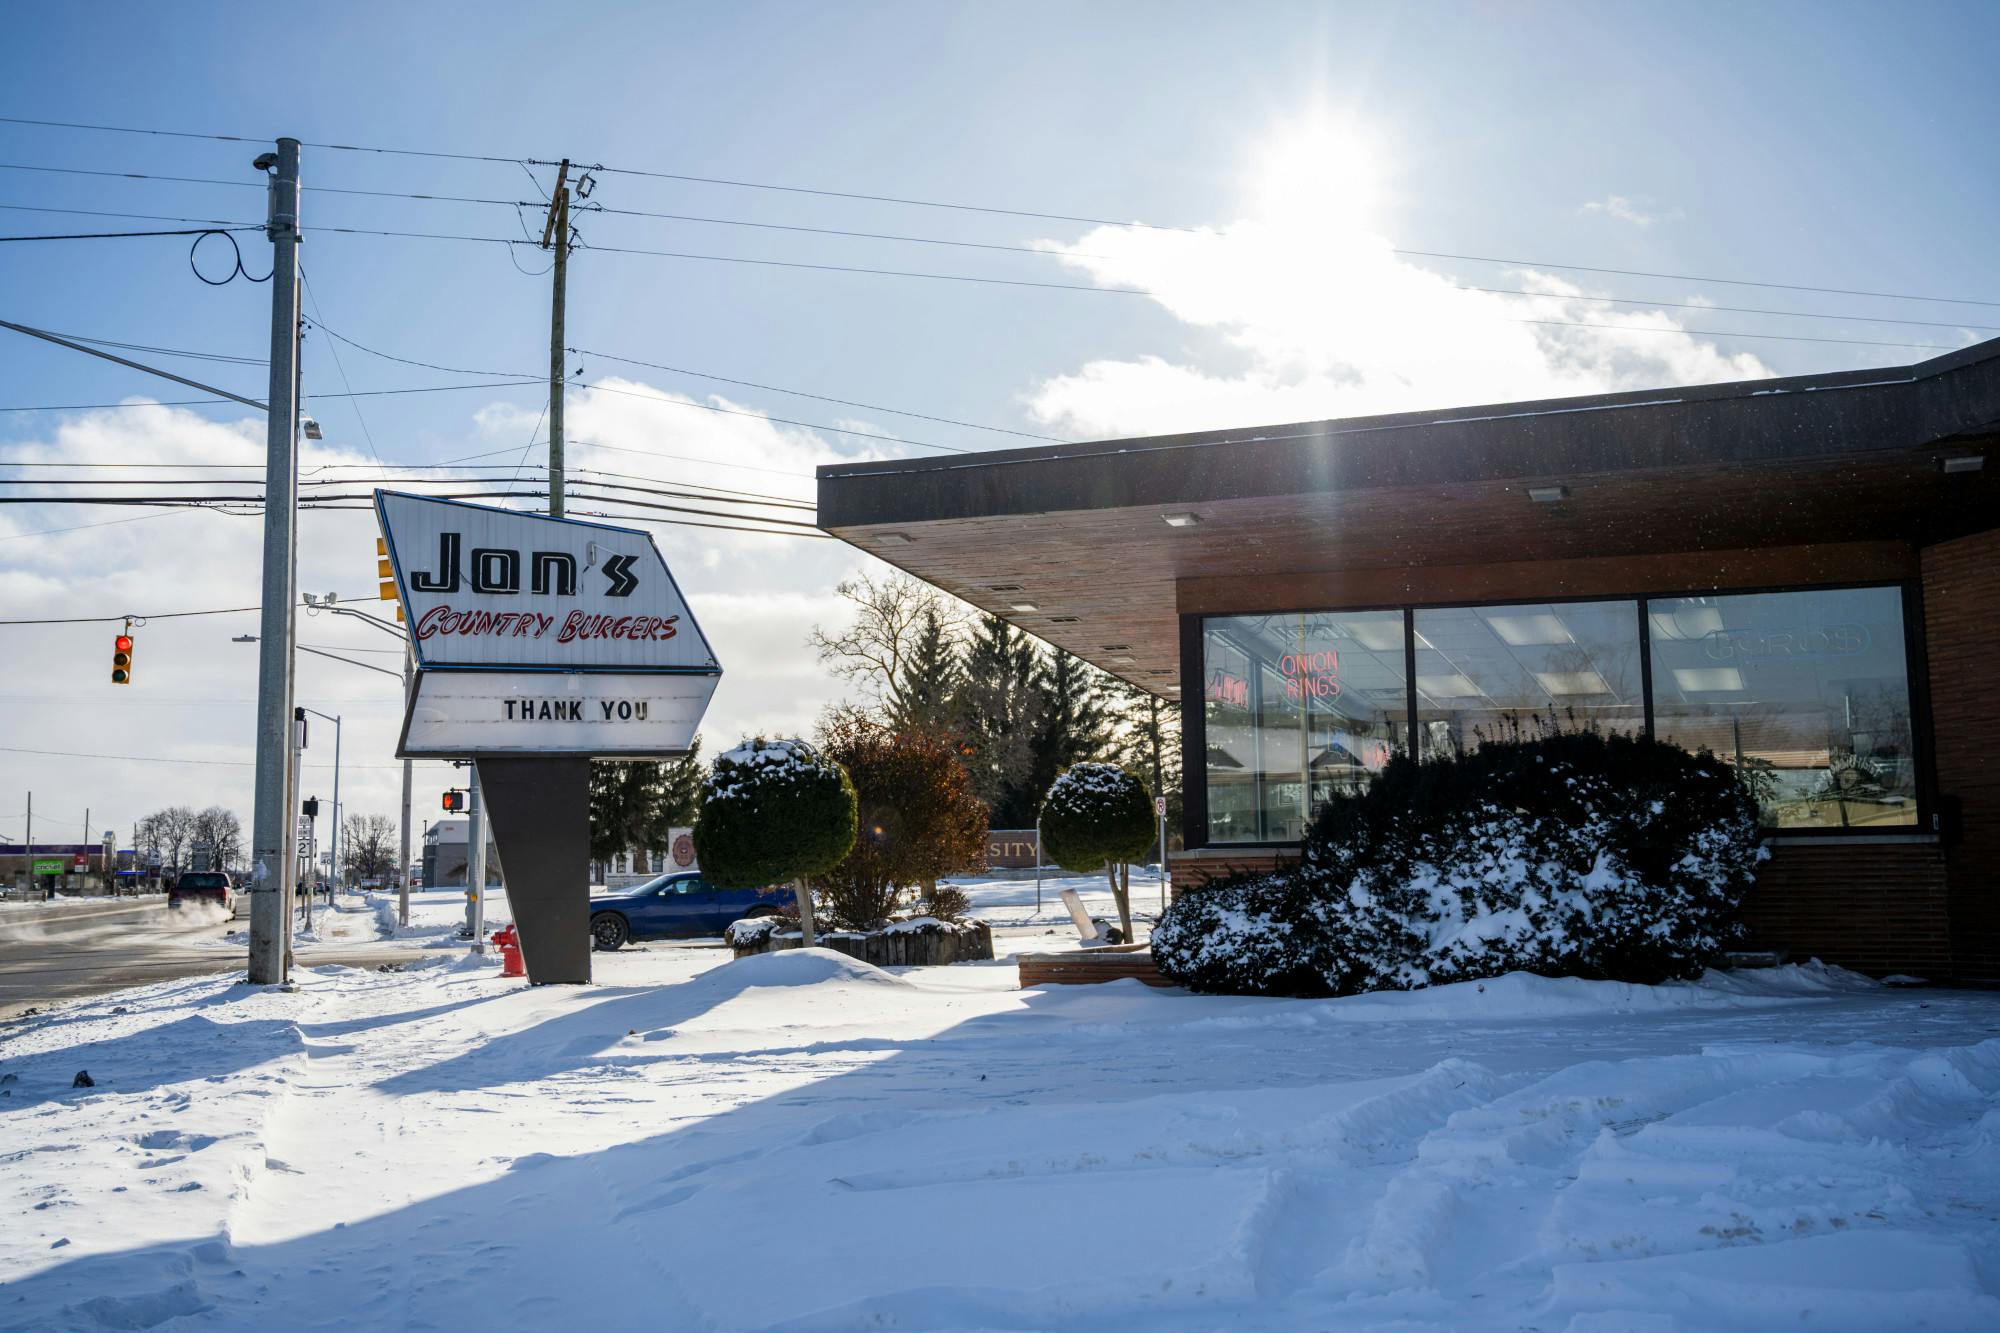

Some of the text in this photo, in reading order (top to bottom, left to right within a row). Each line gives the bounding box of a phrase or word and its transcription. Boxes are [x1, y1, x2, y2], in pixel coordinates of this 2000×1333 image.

[415, 605, 680, 643] COUNTRY BURGERS
[1281, 651, 1338, 676] ONION
[1287, 675, 1340, 698] RINGS
[504, 700, 648, 721] THANK YOU
[984, 842, 1038, 857] SITY
